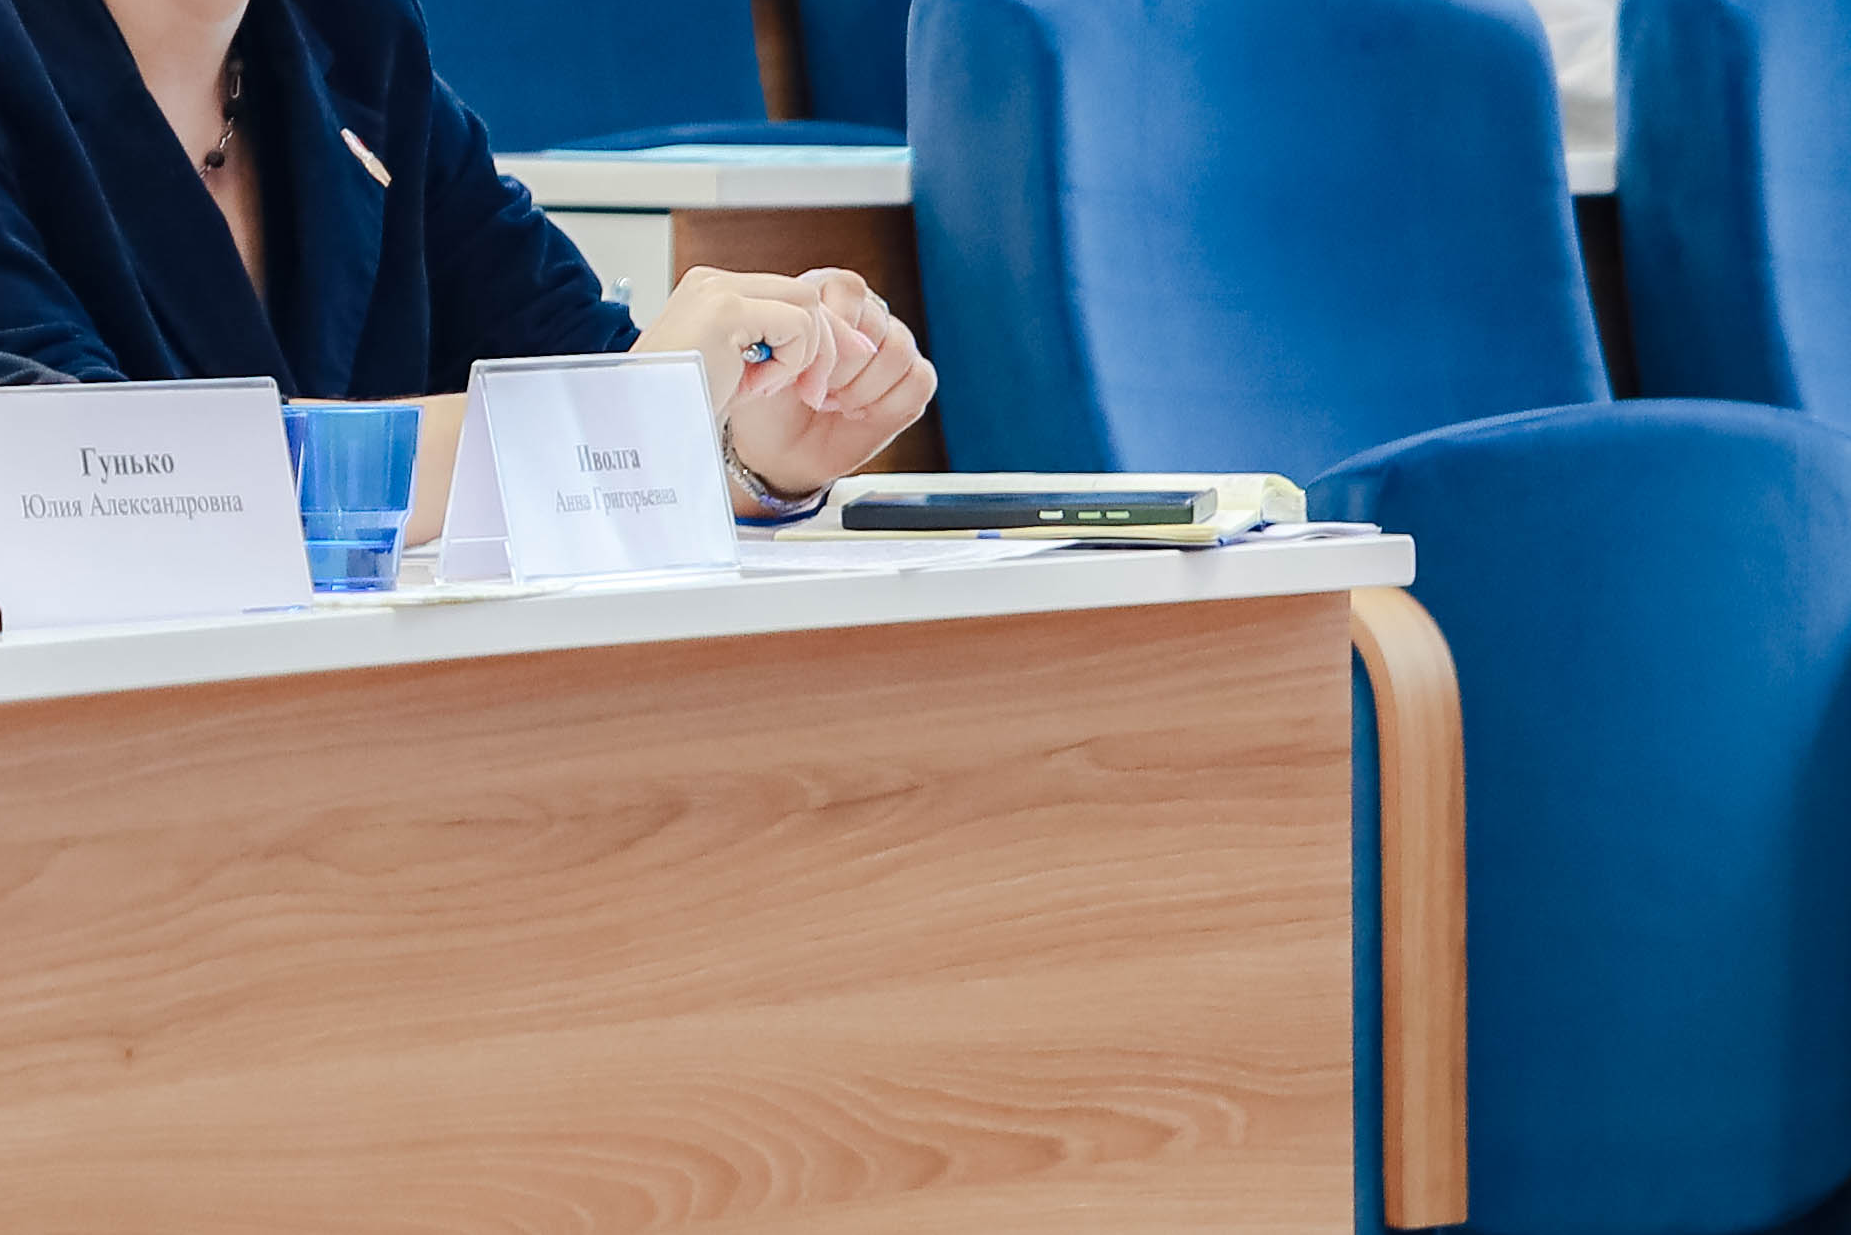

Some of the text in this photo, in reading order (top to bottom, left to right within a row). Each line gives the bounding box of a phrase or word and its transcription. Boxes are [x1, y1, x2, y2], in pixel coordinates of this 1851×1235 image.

[79, 447, 175, 484] Гунько
[576, 444, 641, 472] Иволга
[20, 491, 244, 521] Юлия Александровна
[555, 486, 678, 516] Анна Григорьевна
